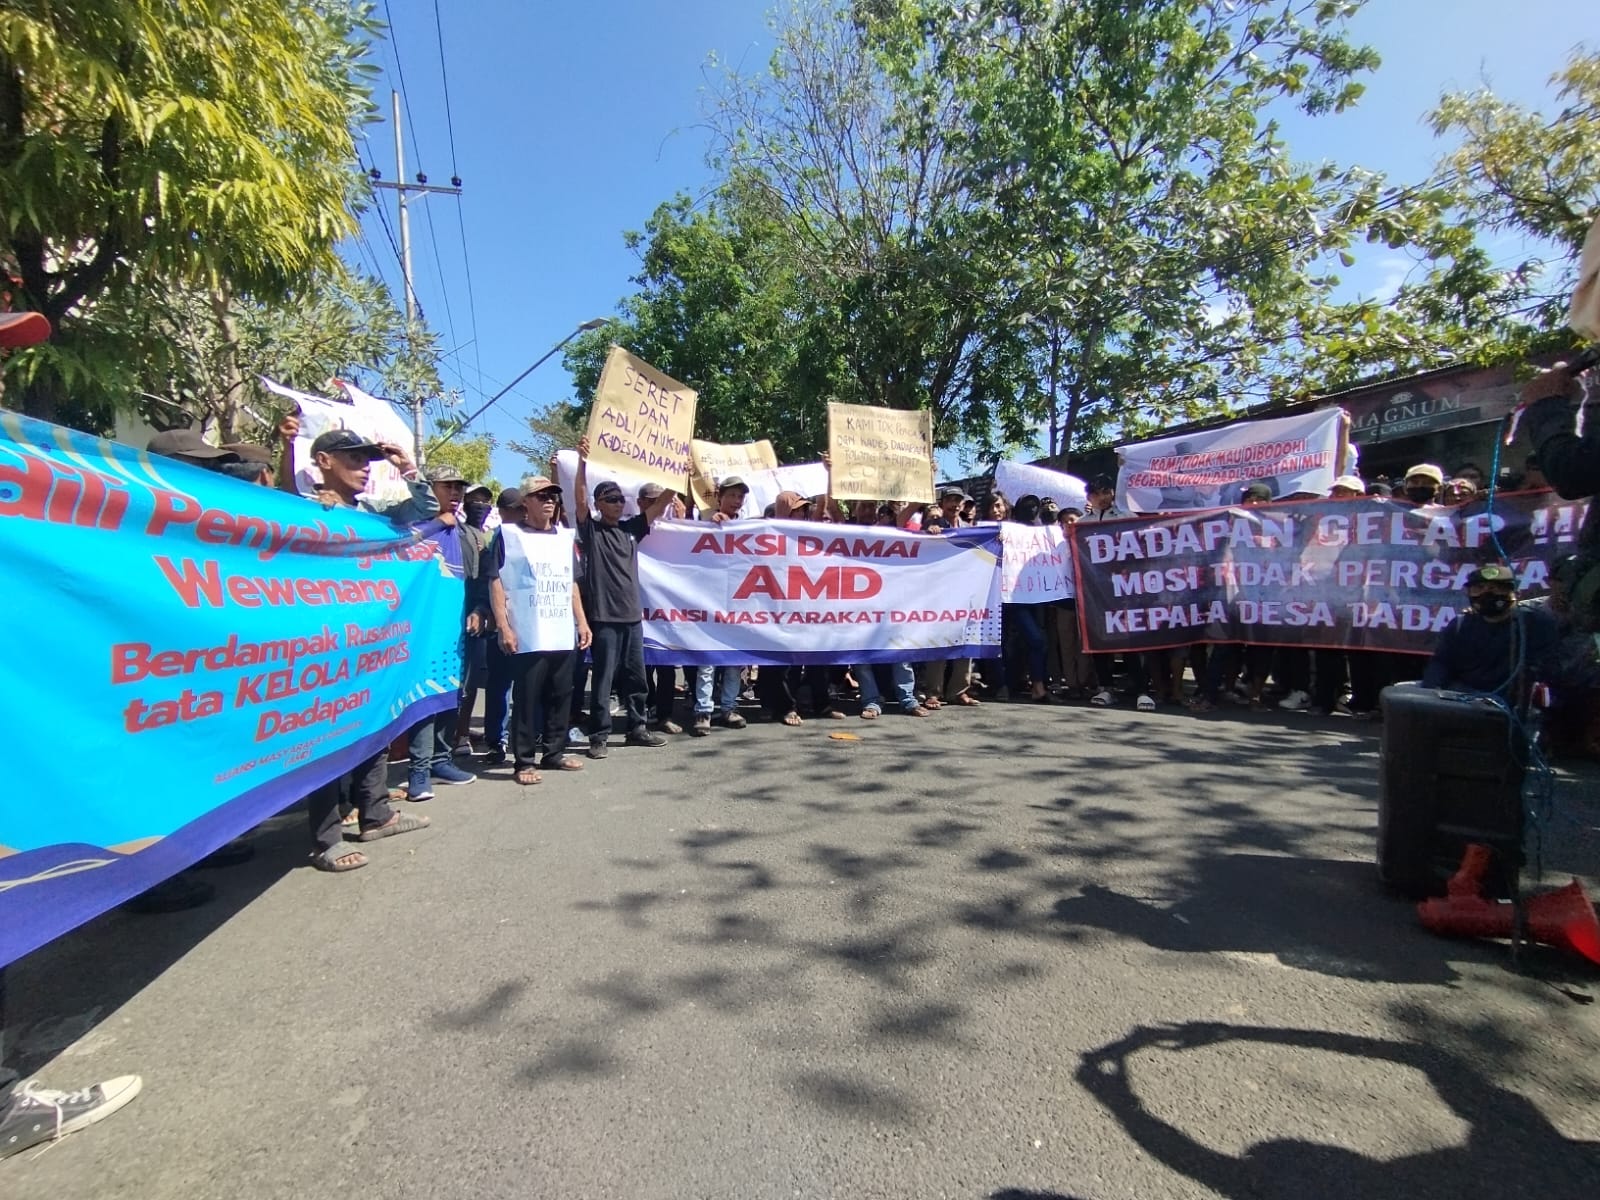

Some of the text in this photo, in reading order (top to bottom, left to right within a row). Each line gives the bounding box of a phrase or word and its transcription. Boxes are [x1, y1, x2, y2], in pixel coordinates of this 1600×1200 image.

[624, 366, 683, 414] SERET
[638, 401, 669, 431] DAN
[1350, 394, 1462, 430] MAGNUM
[1369, 418, 1430, 437] CLASSIC
[1150, 438, 1307, 473] KAMI TIDAK MAU DIBODOHI
[1127, 472, 1169, 488] SEGERA
[1170, 470, 1211, 488] TURUN
[691, 532, 921, 558] AKSI DAMAI
[1087, 517, 1295, 564] DADAPAN
[1317, 511, 1506, 548] GELAP
[154, 555, 400, 609] Wewenang
[732, 565, 883, 601] AMD
[1111, 559, 1550, 597] MOSI TIDAK PERCAA
[642, 607, 990, 625] IANSI MASYARAKAT DADAPAN
[1104, 600, 1229, 634] KEPALA
[1236, 600, 1336, 627] DESA
[111, 626, 338, 685] Berdampak
[122, 688, 224, 733] tata
[234, 659, 350, 709] KELOLA
[254, 688, 371, 743] Dadapan
